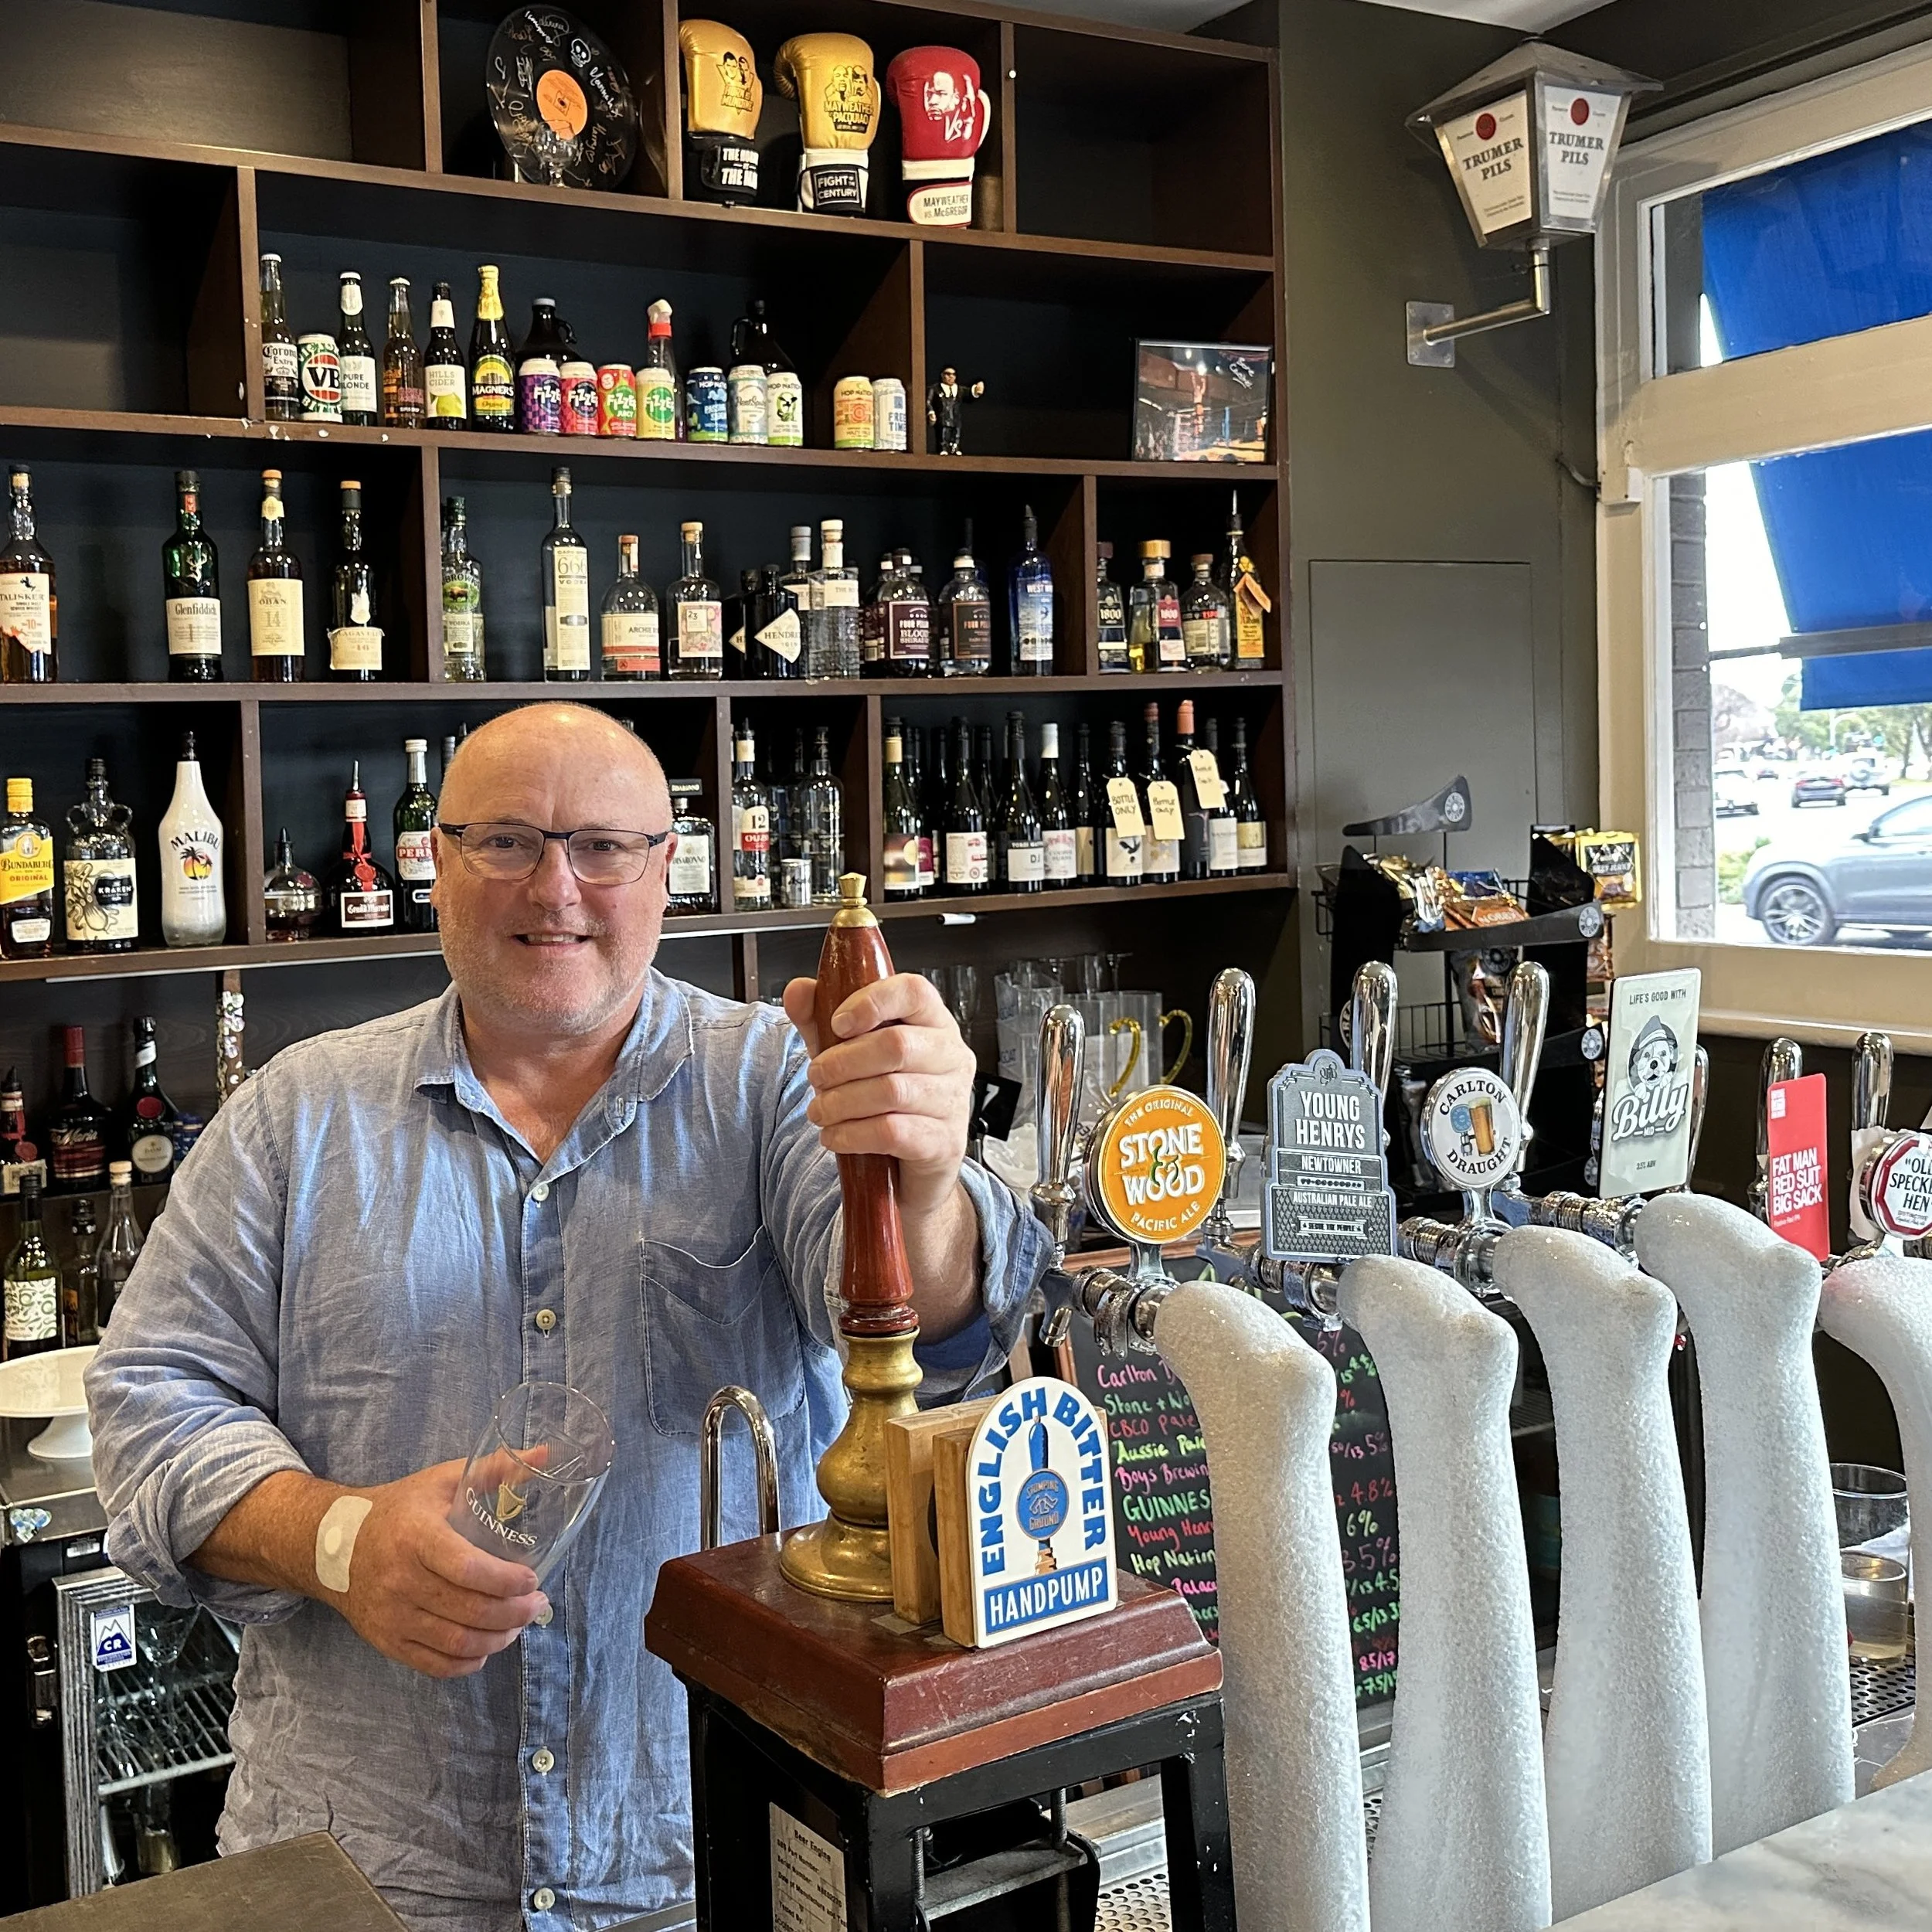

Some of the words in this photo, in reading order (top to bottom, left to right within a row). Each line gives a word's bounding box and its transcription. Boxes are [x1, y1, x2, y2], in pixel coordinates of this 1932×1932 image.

[1549, 131, 1604, 150] TRUMER
[1462, 137, 1524, 171] TRUMER
[1561, 150, 1589, 165] PILS
[818, 175, 849, 189] FIGHT
[1481, 159, 1512, 181] PILS
[818, 186, 858, 200] CENTURY
[472, 385, 514, 396] MAGNERS
[175, 603, 216, 617] Glenfiddich
[266, 611, 281, 628] 14
[1100, 608, 1121, 619] 1800
[750, 814, 767, 829] 12
[1114, 805, 1136, 815] ONLY
[171, 830, 220, 851] MALIBU
[98, 885, 131, 894] KRAKEN
[1629, 992, 1649, 1005] LIFE'S
[1651, 990, 1668, 1002] GOOD
[1671, 988, 1686, 1000] WITH
[1300, 1090, 1360, 1121] YOUNG
[1440, 1080, 1508, 1116] CARLTON
[1124, 1107, 1145, 1127] THE
[1145, 1098, 1194, 1117] ORIGINAL
[1611, 1082, 1689, 1141] Billy
[1119, 1123, 1205, 1169] STONE
[1295, 1118, 1366, 1150] HENRYS
[1301, 1155, 1362, 1175] NEWTOWNER
[1447, 1137, 1512, 1175] DRAUGHT
[1772, 1154, 1792, 1178] FAT
[1793, 1147, 1818, 1172] MAN
[1122, 1165, 1206, 1206] WOOD
[1773, 1172, 1796, 1196] RED
[1797, 1165, 1821, 1190] SUIT
[1293, 1191, 1338, 1206] AUSTRALIAN
[1340, 1194, 1357, 1206] PALE
[1359, 1196, 1372, 1207] ALE
[1773, 1194, 1793, 1216] BIG
[1793, 1183, 1823, 1210] SACK
[1903, 1192, 1930, 1213] HEN
[1131, 1210, 1178, 1232] PACIFIC
[1181, 1200, 1201, 1224] ALE
[1097, 1364, 1156, 1388] Carlton
[1104, 1393, 1152, 1416] Stone
[1114, 1439, 1169, 1464] Aussie
[978, 1387, 1048, 1577] ENGLISH
[1053, 1391, 1107, 1551] BITTER
[1115, 1466, 1158, 1495] Boys
[465, 1487, 538, 1547] GUINNESS
[1123, 1488, 1211, 1522] GUINNES
[1029, 1510, 1060, 1532] GROUND
[1346, 1509, 1379, 1538] 6%
[1127, 1523, 1181, 1552] Young
[1130, 1553, 1161, 1577] Hop
[1163, 1548, 1216, 1568] Nation
[989, 1566, 1104, 1627] HANDPUMP
[104, 1638, 122, 1651] CR
